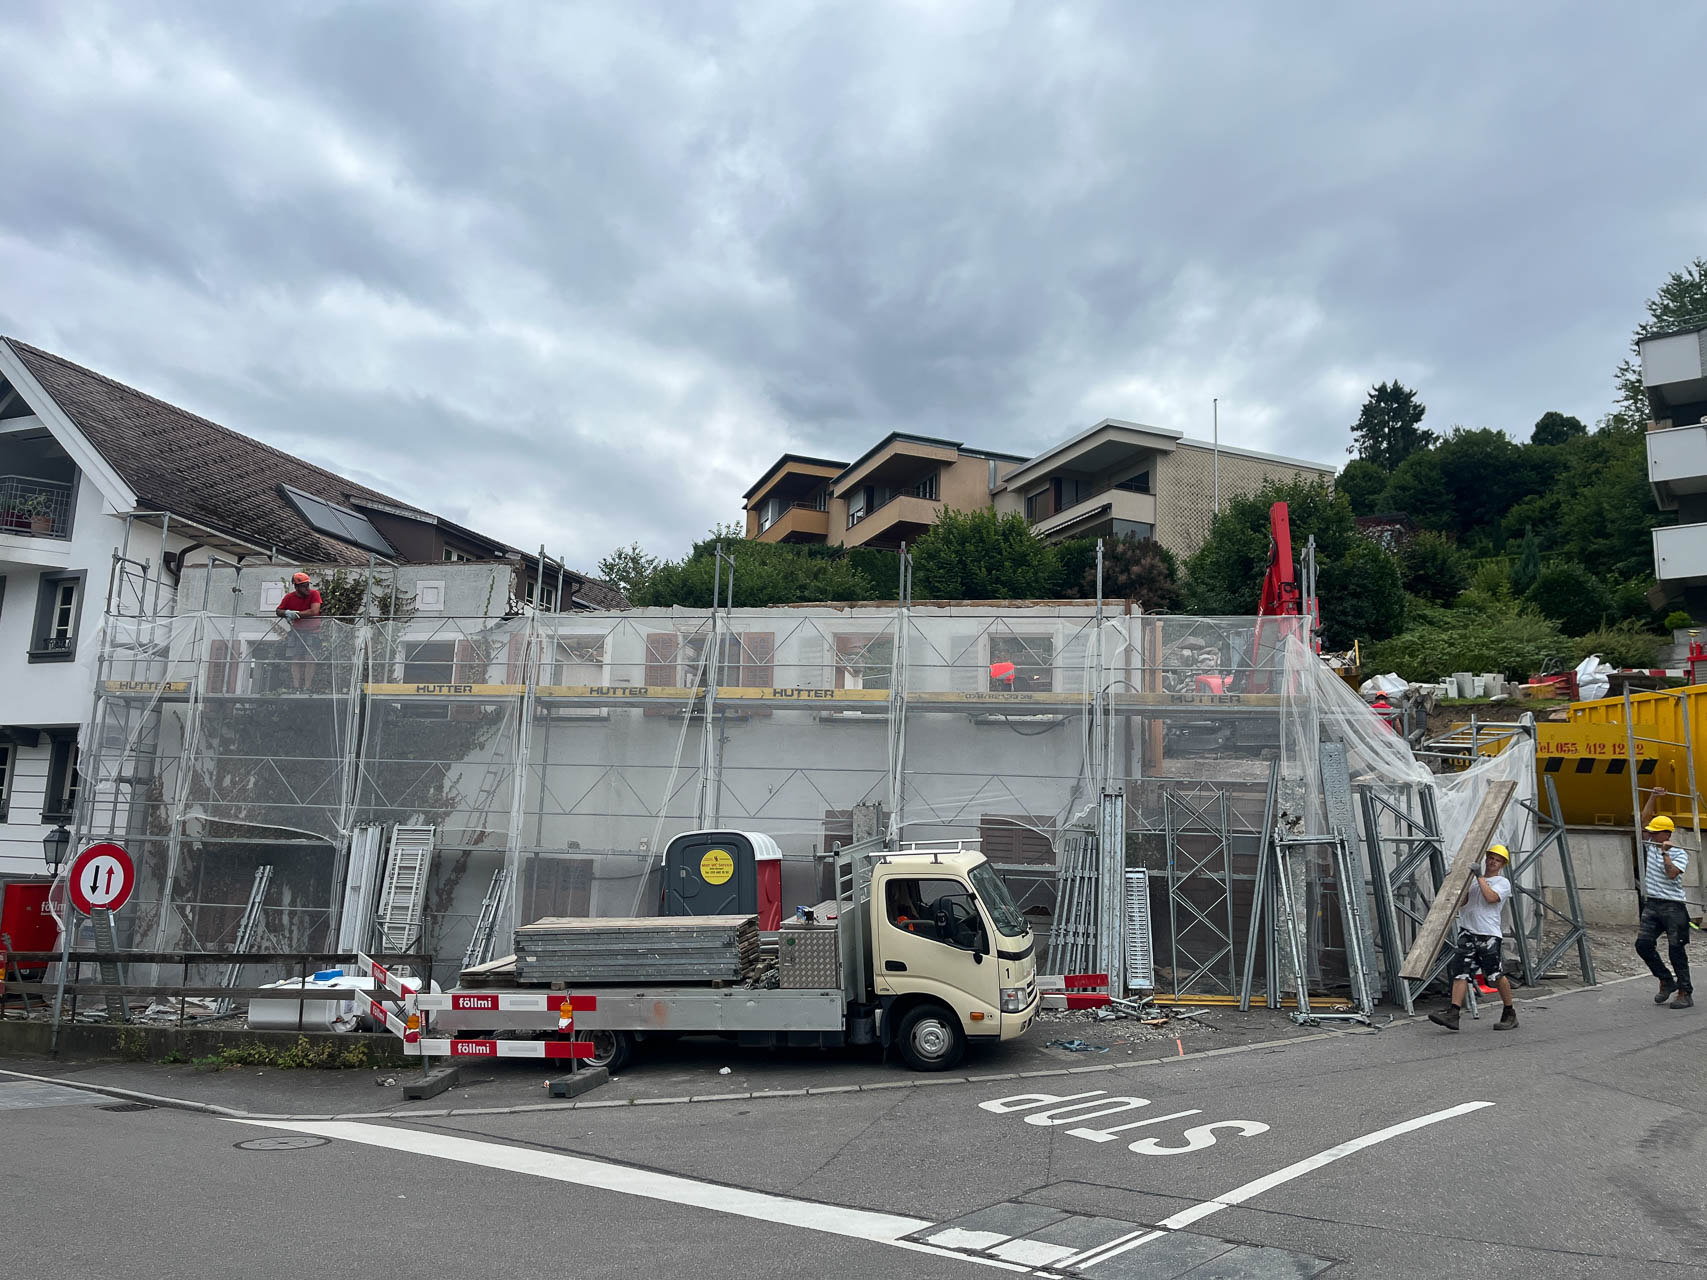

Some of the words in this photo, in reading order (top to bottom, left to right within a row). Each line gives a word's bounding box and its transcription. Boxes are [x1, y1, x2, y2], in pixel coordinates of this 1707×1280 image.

[416, 684, 473, 693] HUTTER
[590, 686, 649, 696] HUTTER
[773, 688, 835, 698] HUTTER
[1170, 694, 1241, 704] HUTTER
[1555, 742, 1578, 754] 055
[1585, 743, 1607, 755] 412
[1613, 743, 1626, 755] 12
[1005, 967, 1010, 979] 1
[459, 996, 492, 1009] föllmi
[457, 1042, 490, 1055] föllmi
[978, 1090, 1271, 1156] STOP
